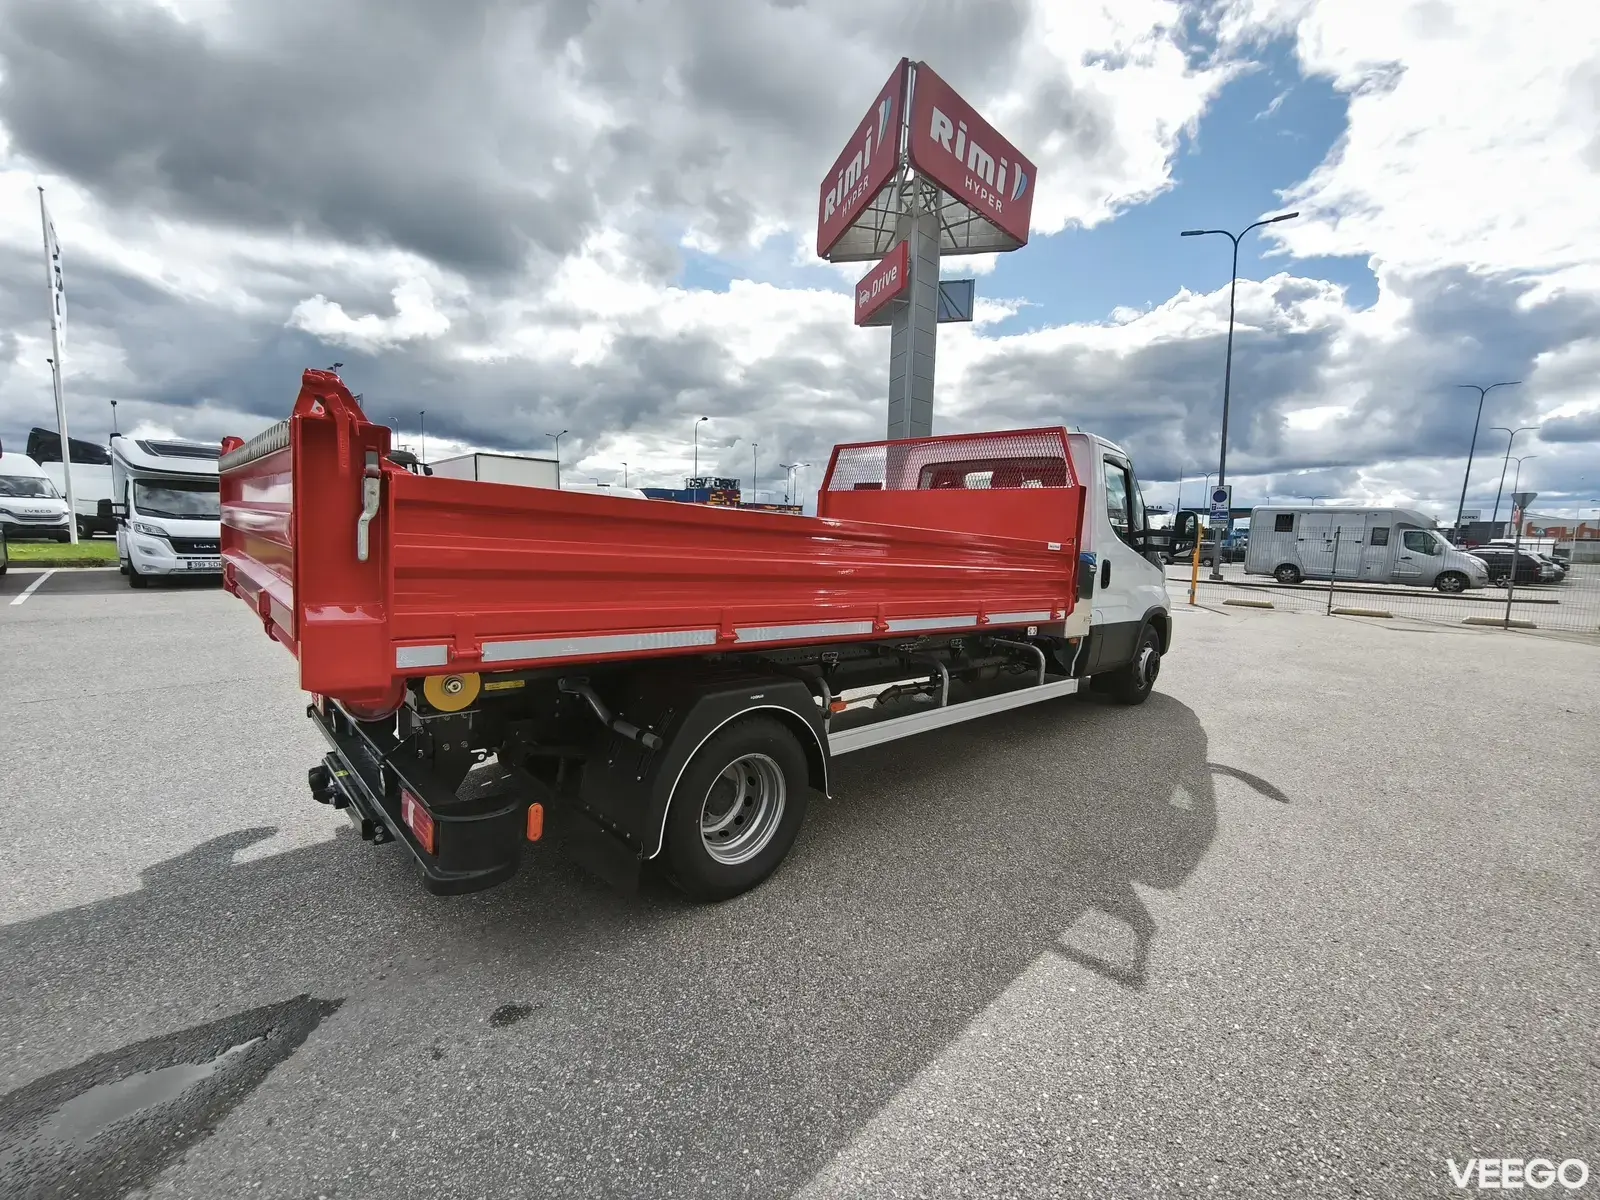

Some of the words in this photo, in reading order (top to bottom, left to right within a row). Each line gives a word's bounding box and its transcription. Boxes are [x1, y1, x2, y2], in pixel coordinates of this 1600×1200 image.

[930, 106, 1007, 194] Rimi
[824, 125, 872, 224] Rimi
[965, 175, 1002, 213] HYPER
[842, 175, 869, 218] HYPER
[871, 265, 897, 297] Drive
